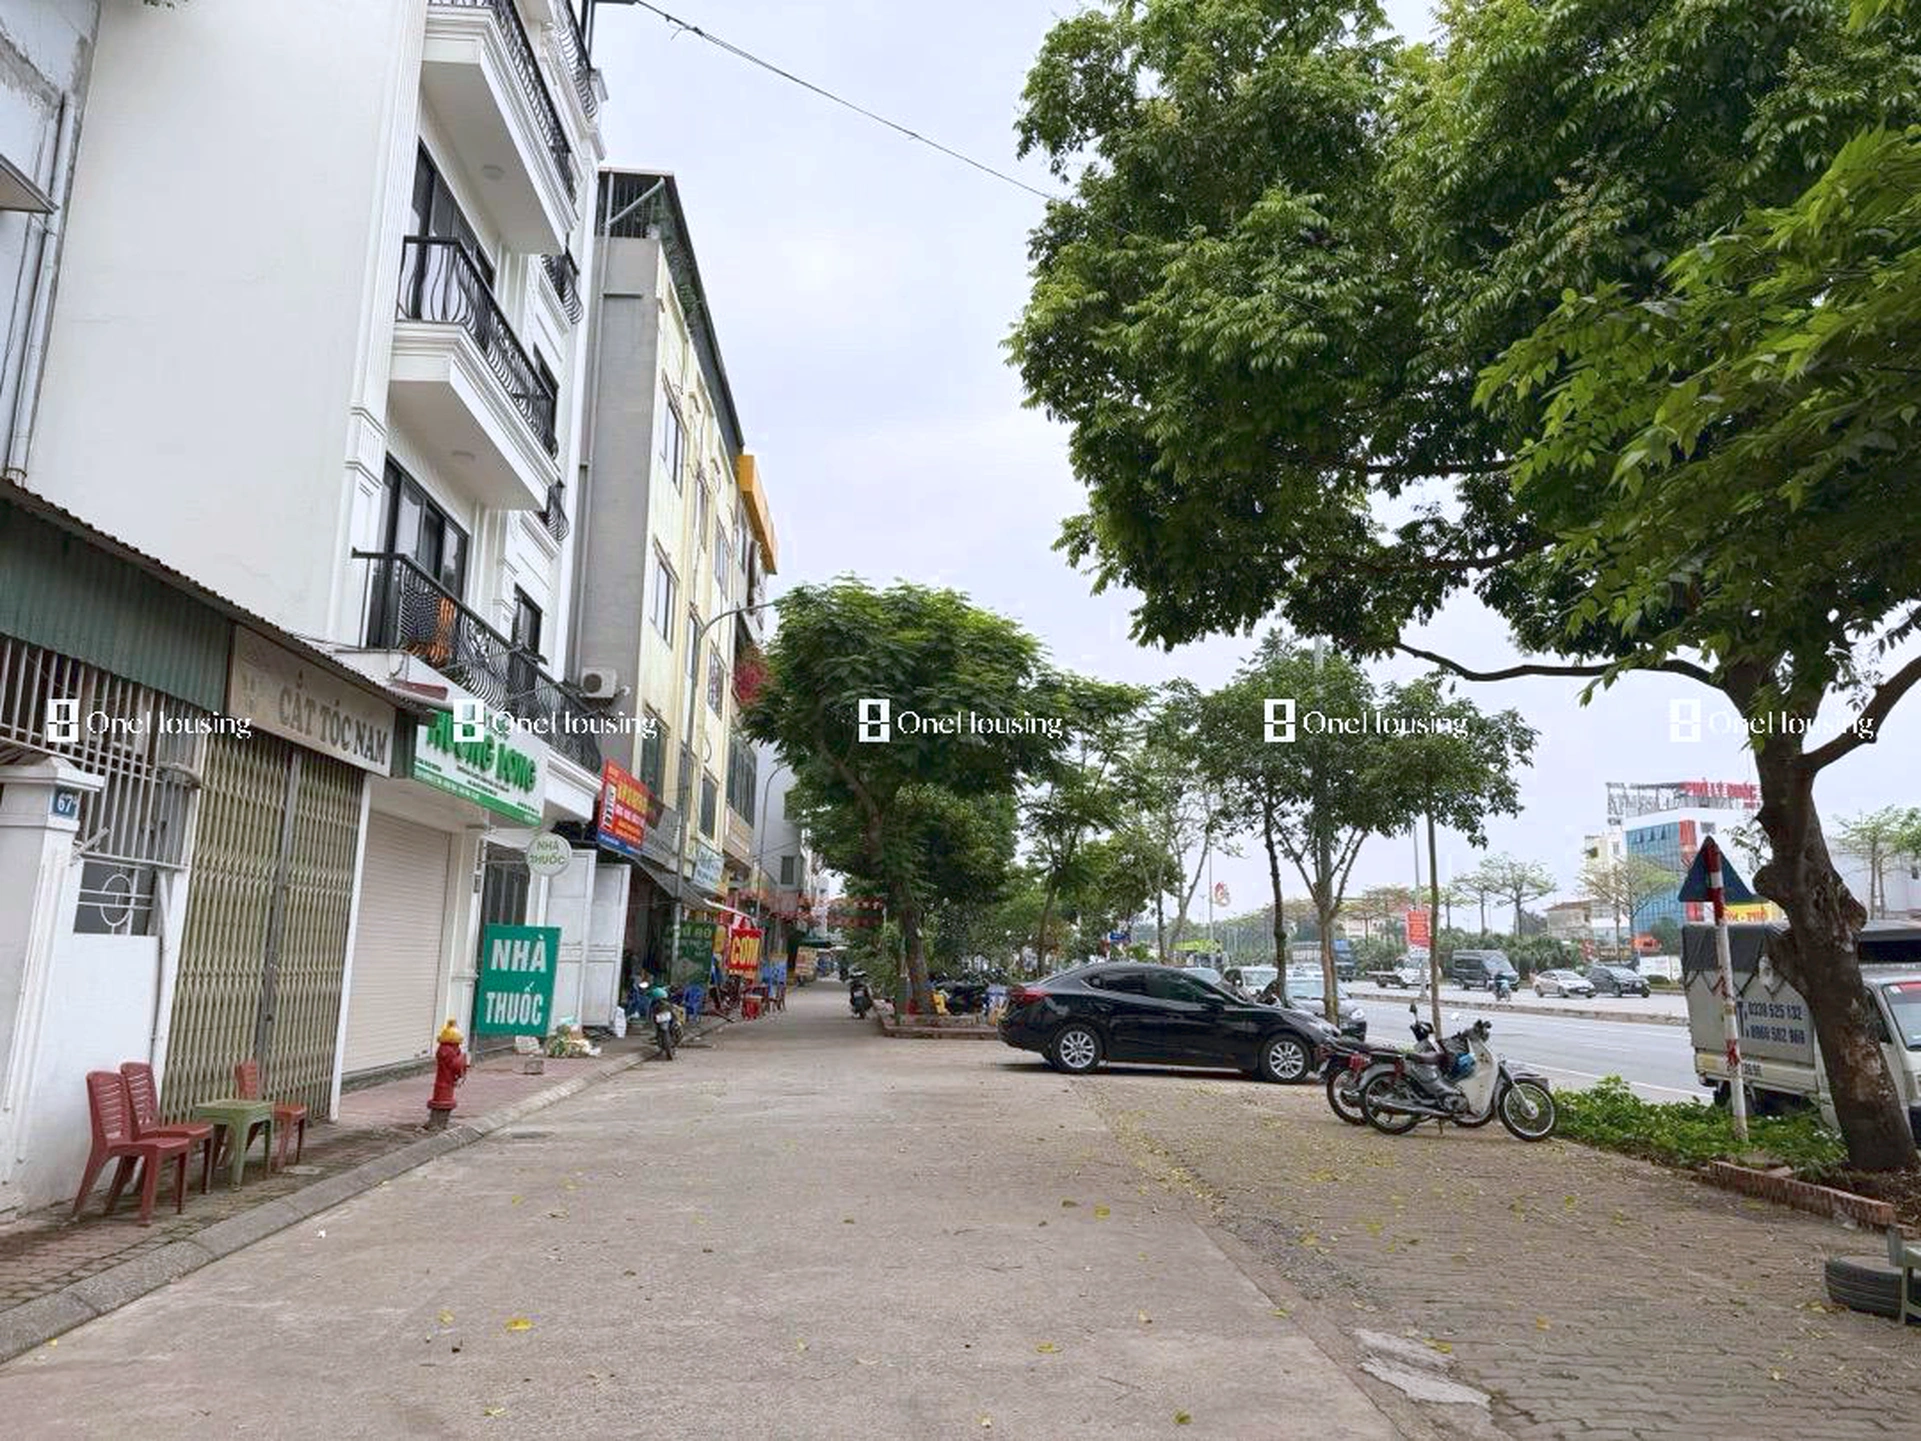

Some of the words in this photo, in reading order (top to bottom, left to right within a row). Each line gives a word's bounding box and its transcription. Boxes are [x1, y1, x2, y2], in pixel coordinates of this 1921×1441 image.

[353, 719, 388, 766] NAM
[490, 934, 547, 973] NHÀ
[485, 981, 544, 1026] THUỐC
